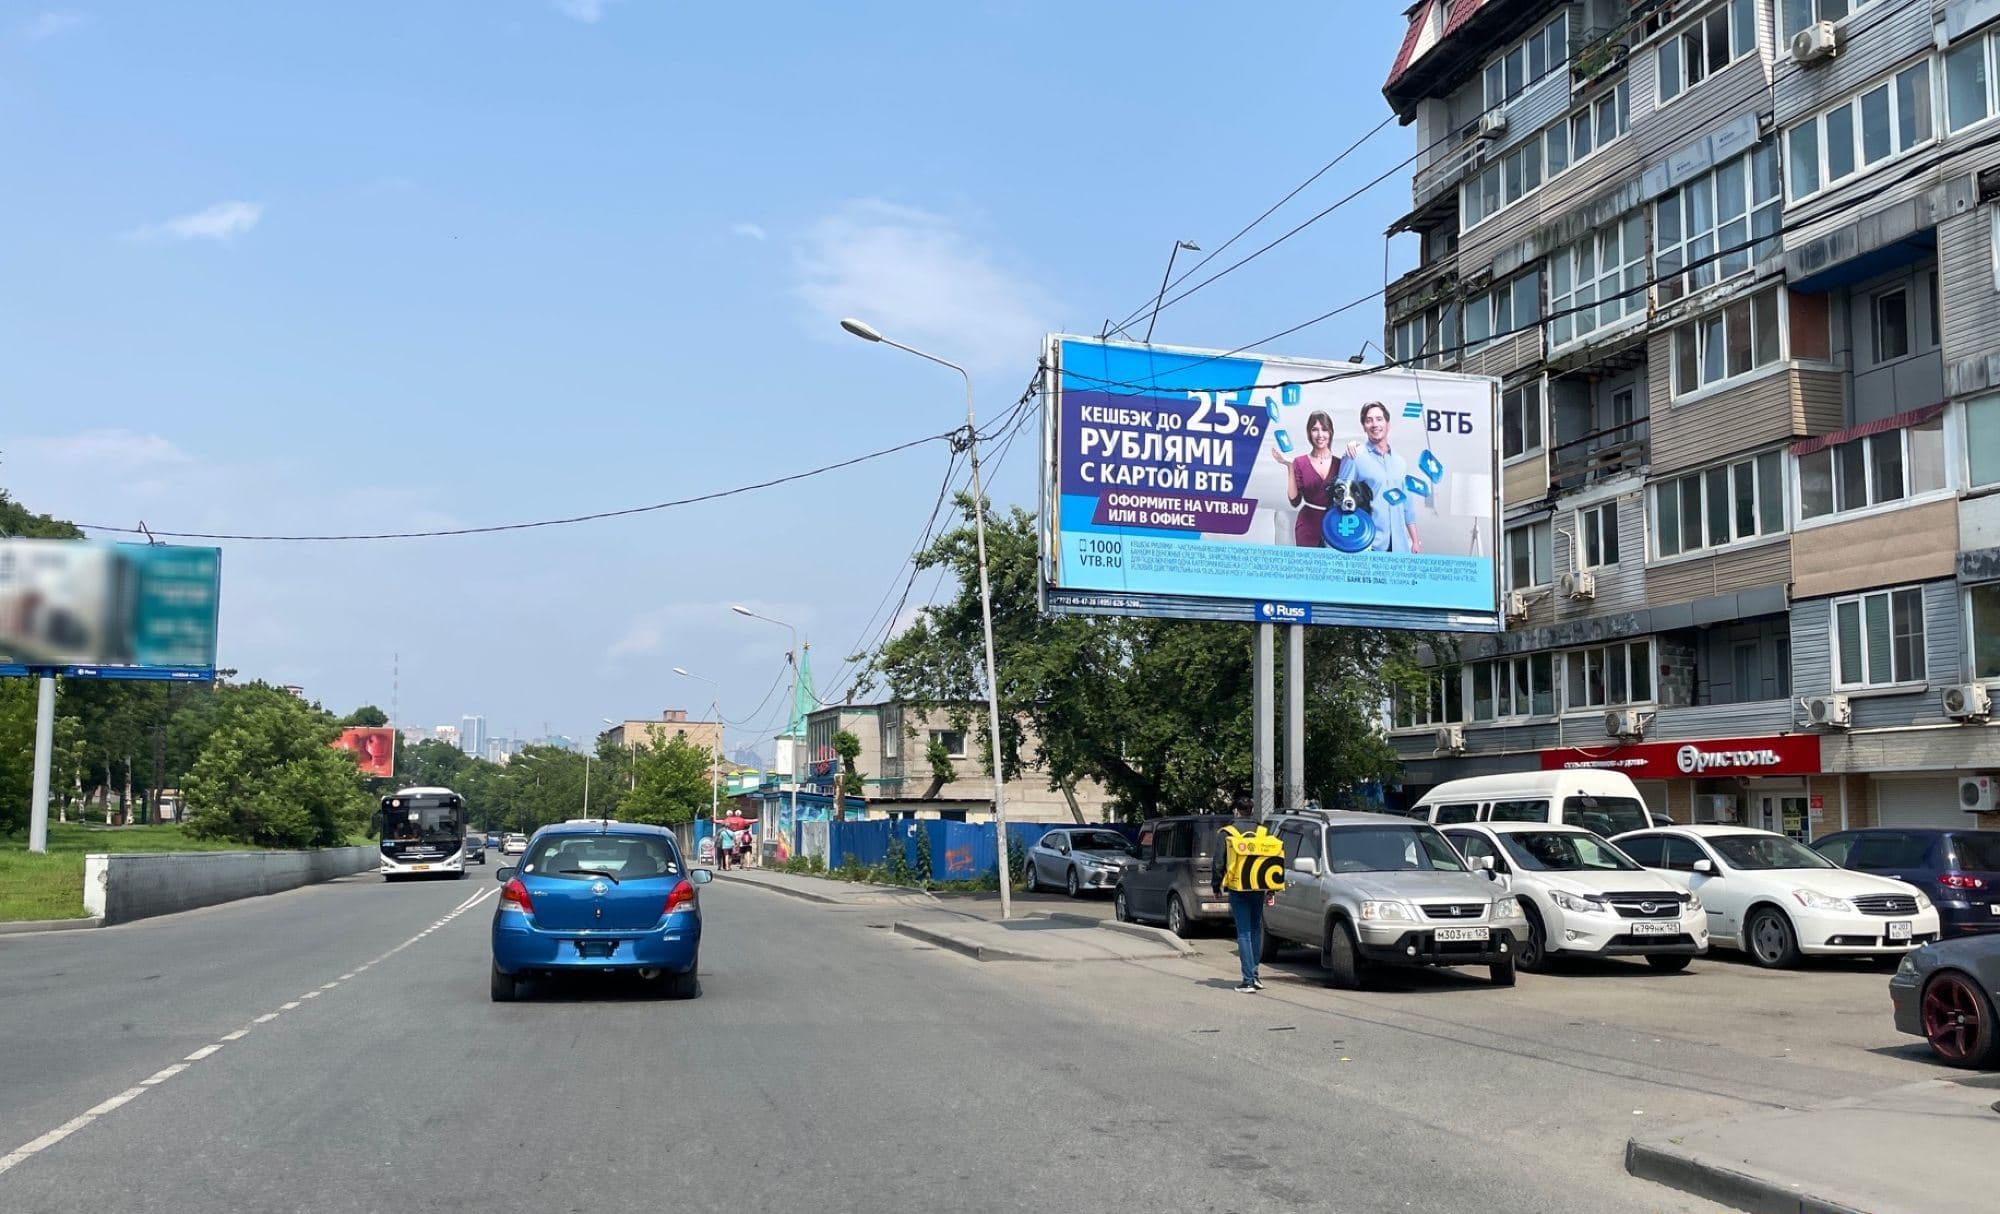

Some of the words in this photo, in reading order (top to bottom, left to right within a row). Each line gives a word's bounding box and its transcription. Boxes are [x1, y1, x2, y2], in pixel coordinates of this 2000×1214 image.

[1081, 405, 1151, 427] КЕШБЭК
[1156, 413, 1182, 432] ДО
[1186, 390, 1259, 437] 25%
[1426, 409, 1473, 434] ВТБ
[1080, 427, 1233, 467] РУБЛЯМИ
[1080, 462, 1094, 482] С
[1101, 463, 1189, 490] КАРТОЙ
[1195, 472, 1233, 492] ВТБ
[1108, 494, 1181, 511] ОФОРМИТЕ
[1184, 498, 1202, 512] НА
[1204, 500, 1249, 515] VTB.RU
[1108, 508, 1137, 523] ИЛИ
[1140, 511, 1148, 524] В
[1150, 512, 1196, 527] ОФИСЕ
[1090, 540, 1121, 554] 1000
[1080, 554, 1122, 568] VTB.RU
[1276, 604, 1305, 617] Russ
[1677, 745, 1780, 773] Бристоль
